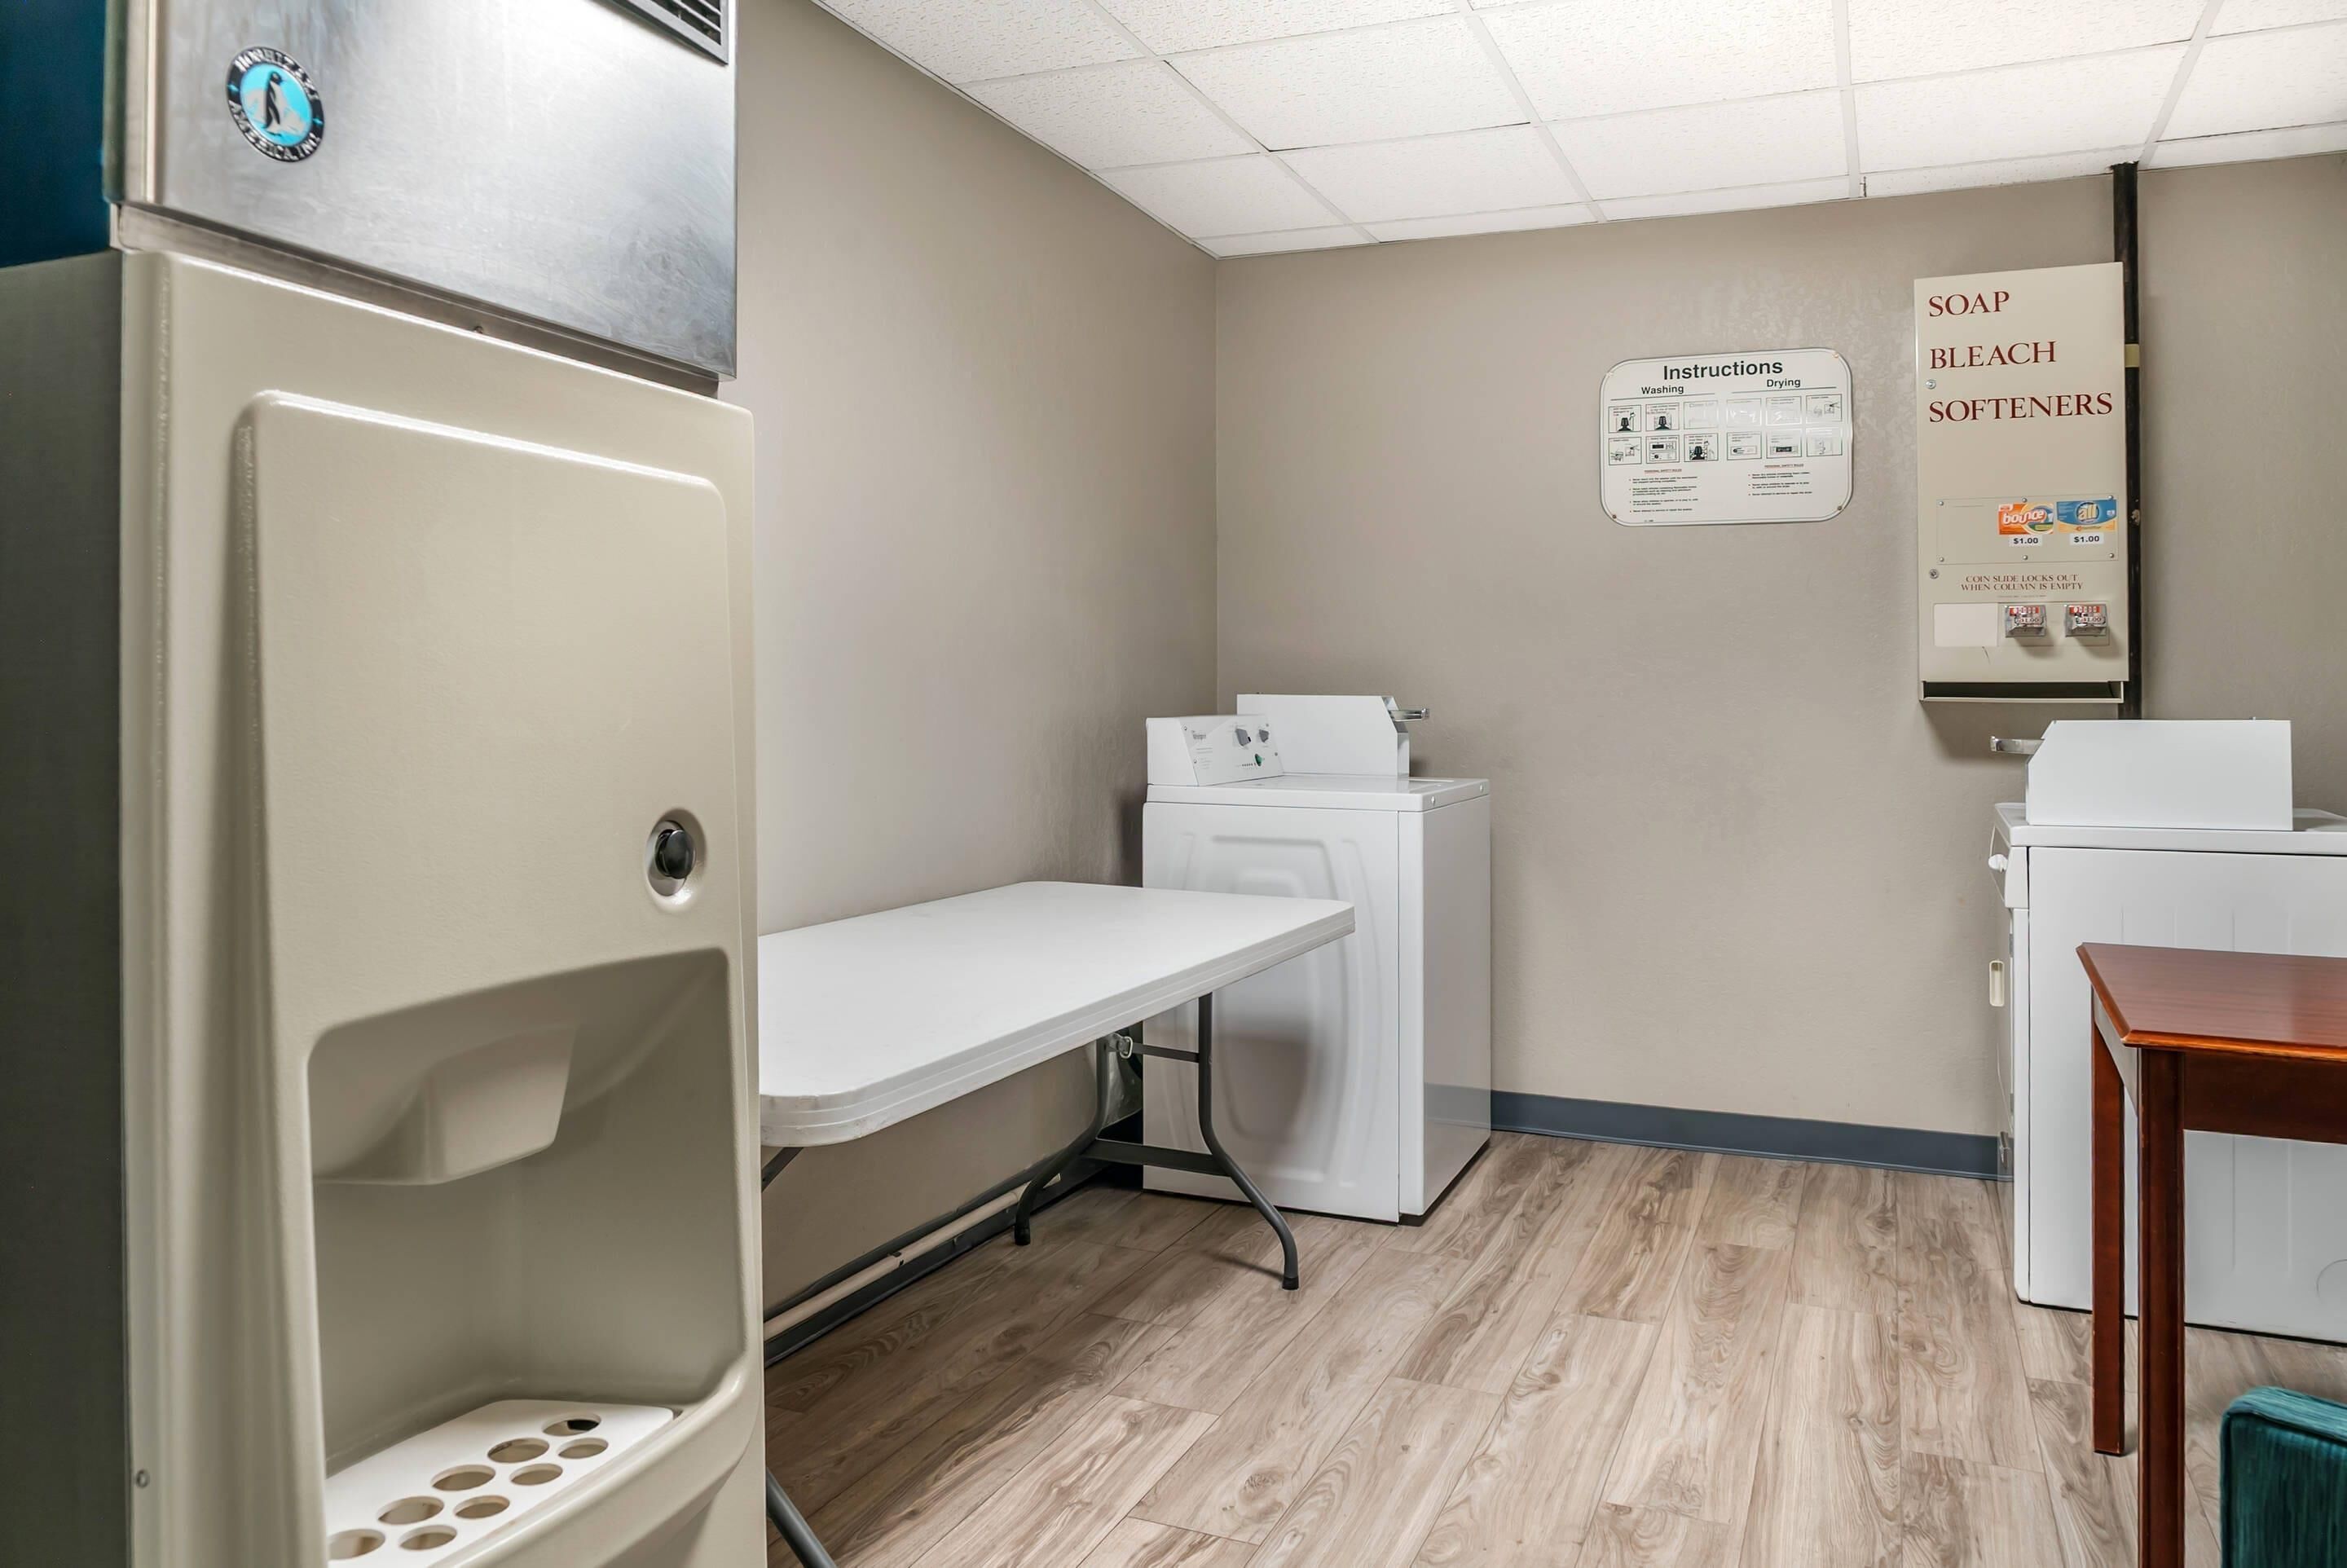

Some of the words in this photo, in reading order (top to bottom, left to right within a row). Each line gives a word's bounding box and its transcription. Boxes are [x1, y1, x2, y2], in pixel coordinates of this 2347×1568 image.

[1928, 290, 2010, 318] SOAP
[1930, 340, 2058, 369] BLEACH
[1663, 359, 1783, 381] Instructions
[1641, 385, 1684, 395] Washing
[1766, 378, 1801, 388] Drying
[1929, 392, 2113, 423] SOFTENERS
[2003, 509, 2045, 525] bounce
[2078, 504, 2098, 521] all
[1993, 575, 2019, 583] SLIDE
[2022, 574, 2054, 582] LOCKS
[2057, 574, 2078, 582] OUT
[1993, 583, 2036, 591] COLUMN
[2050, 582, 2084, 590] EMPTY
